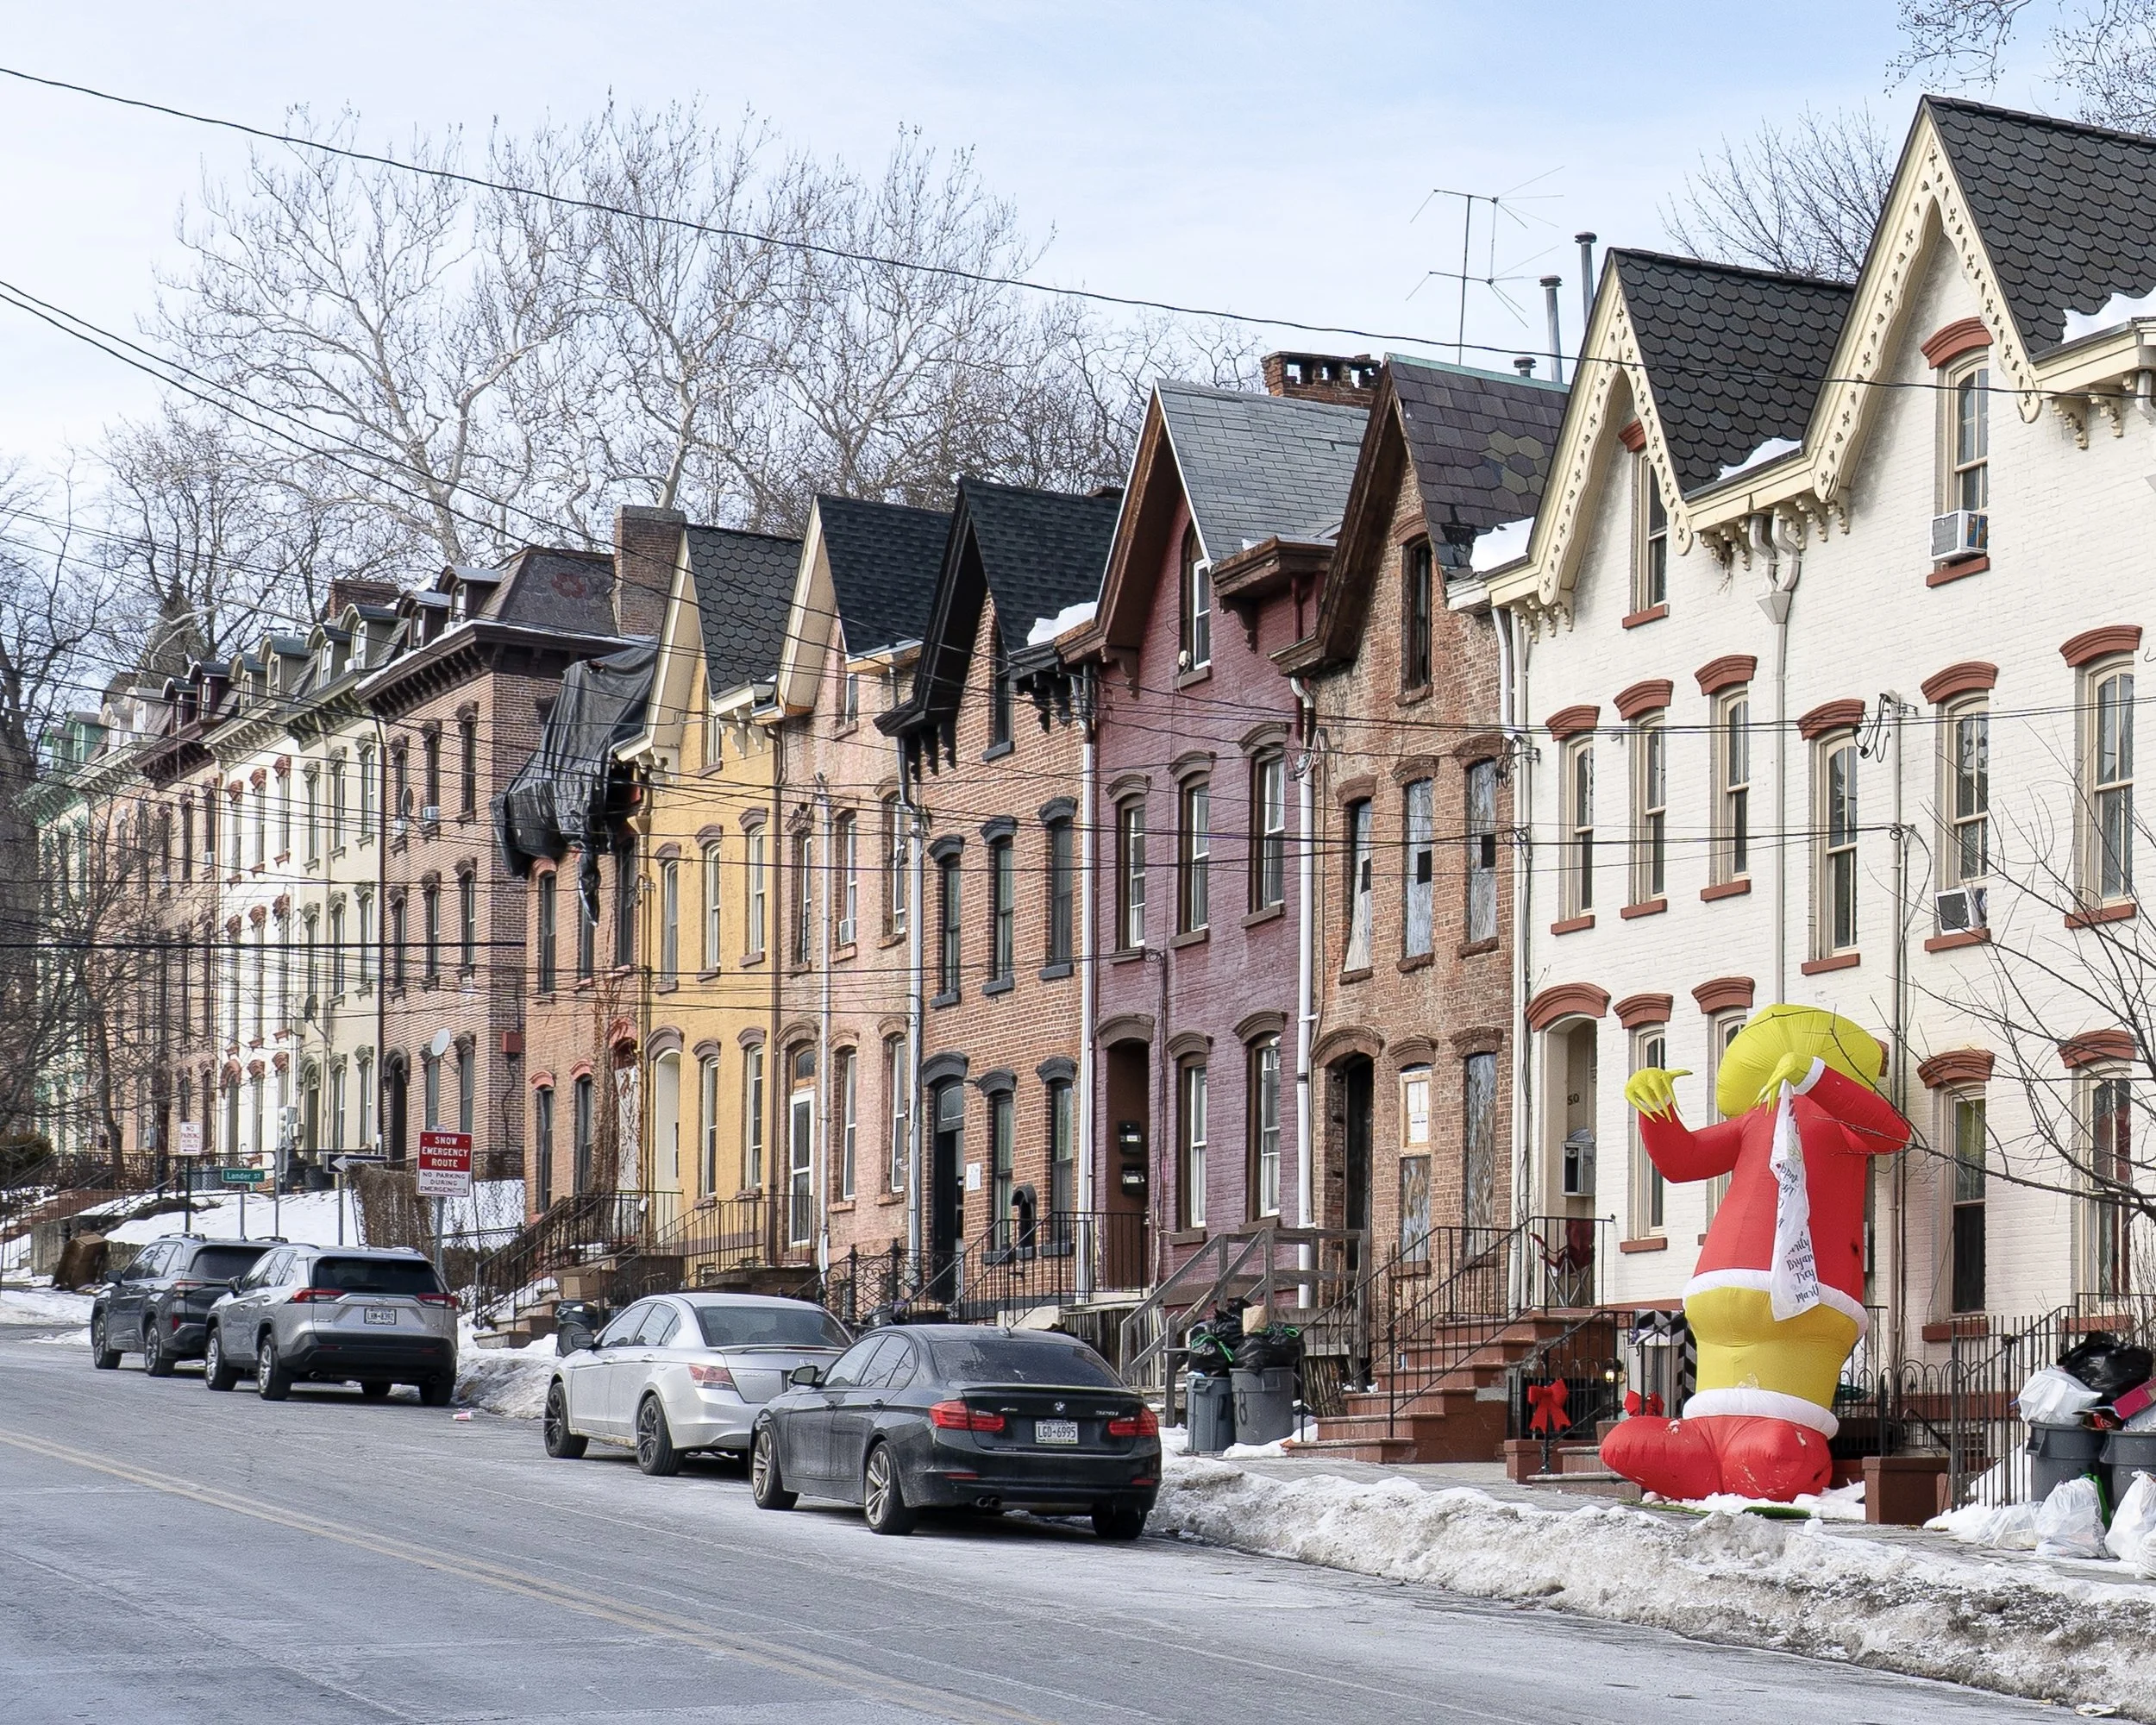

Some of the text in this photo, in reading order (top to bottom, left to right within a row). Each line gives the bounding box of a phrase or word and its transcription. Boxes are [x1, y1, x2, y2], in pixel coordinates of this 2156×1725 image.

[1567, 1093, 1580, 1106] 50
[435, 1136, 458, 1145] SNOW
[422, 1146, 469, 1157] EMERGENCY
[431, 1157, 459, 1168] ROUTE
[226, 1171, 251, 1180] Lander
[1786, 1253, 1814, 1272] Bryan
